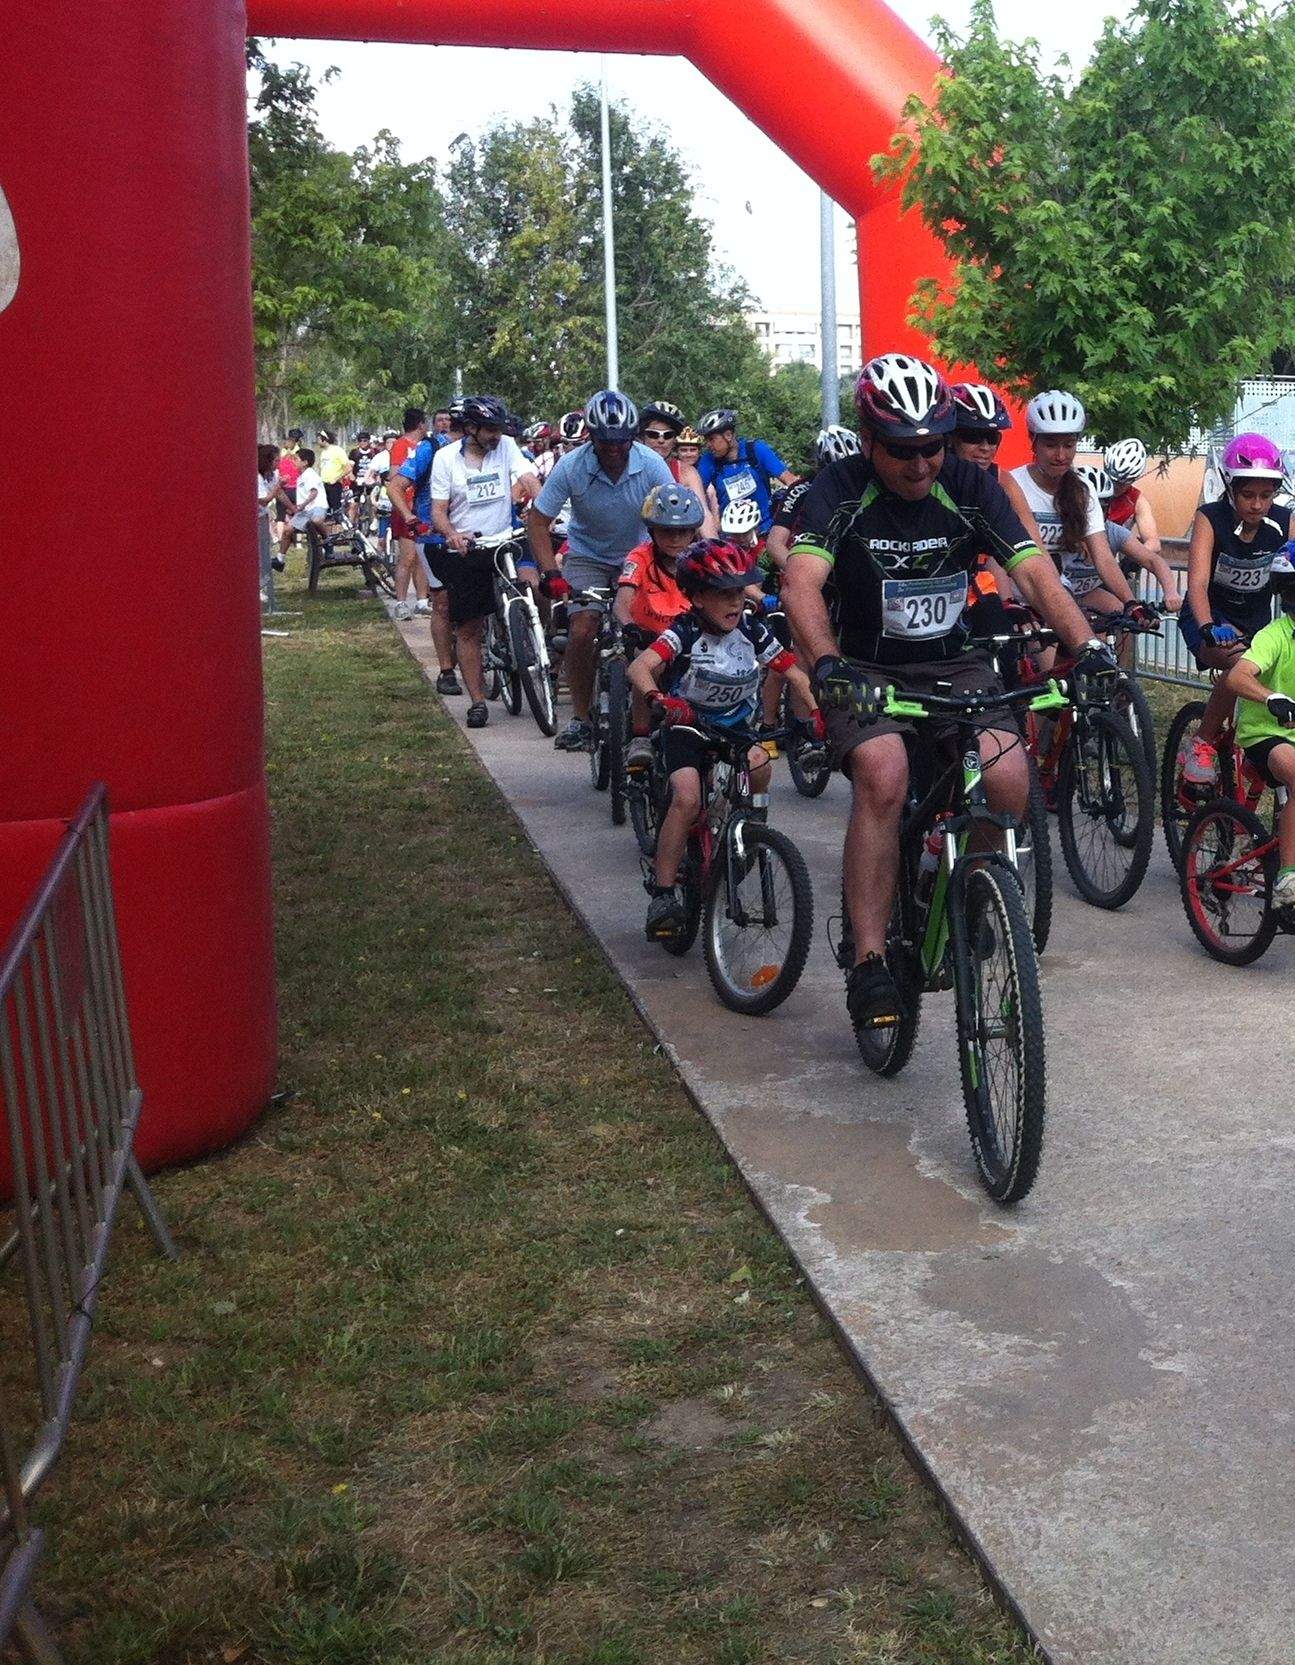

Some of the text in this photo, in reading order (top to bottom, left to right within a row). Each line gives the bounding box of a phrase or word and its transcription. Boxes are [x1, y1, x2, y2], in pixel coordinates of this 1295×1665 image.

[477, 482, 496, 498] 212
[1074, 577, 1100, 593] 267
[1230, 570, 1261, 587] 223
[906, 595, 947, 630] 230
[705, 686, 743, 703] 250
